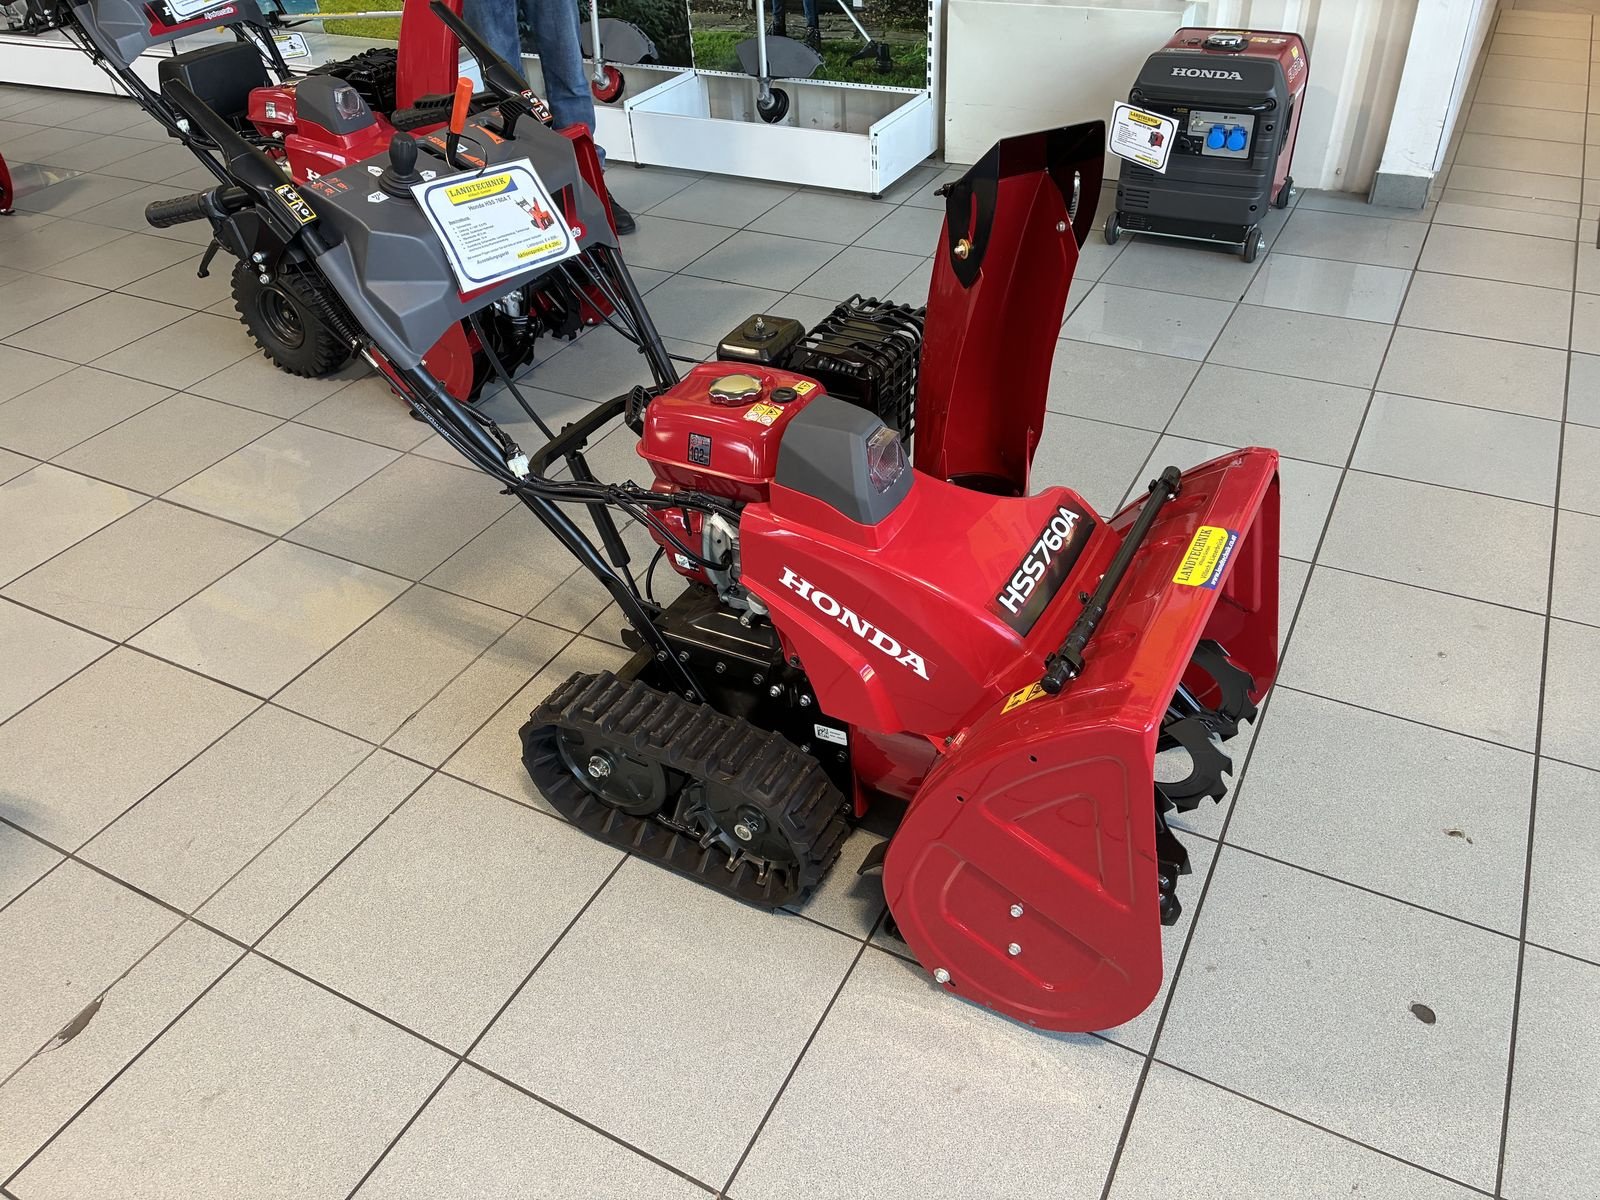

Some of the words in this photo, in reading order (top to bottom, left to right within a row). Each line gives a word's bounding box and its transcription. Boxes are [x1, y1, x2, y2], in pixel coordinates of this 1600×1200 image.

[1170, 67, 1243, 81] HONDA
[449, 177, 507, 197] LANDTECHNIK
[468, 202, 485, 211] Honda
[484, 199, 496, 207] HSS
[690, 446, 705, 463] 102
[999, 507, 1079, 614] HSS760A
[1177, 529, 1212, 581] LANDTECHNIK
[778, 566, 930, 681] HONDA
